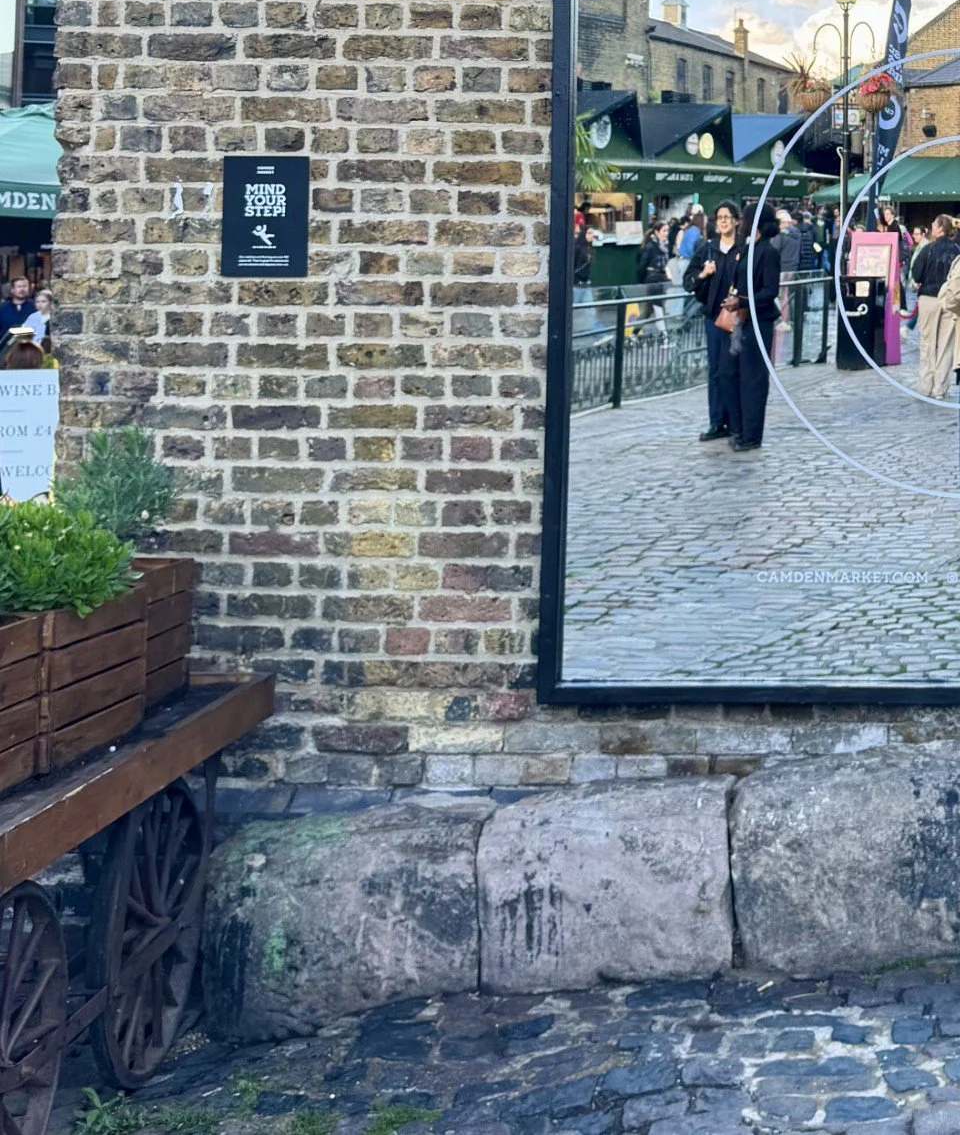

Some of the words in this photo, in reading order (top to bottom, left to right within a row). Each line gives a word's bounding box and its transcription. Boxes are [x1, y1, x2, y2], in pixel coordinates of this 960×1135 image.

[245, 183, 286, 195] MIND
[244, 194, 286, 206] YOUR
[244, 205, 286, 217] STEP!
[0, 384, 42, 397] WINE
[756, 570, 929, 584] CAMDENMARKET.COM
